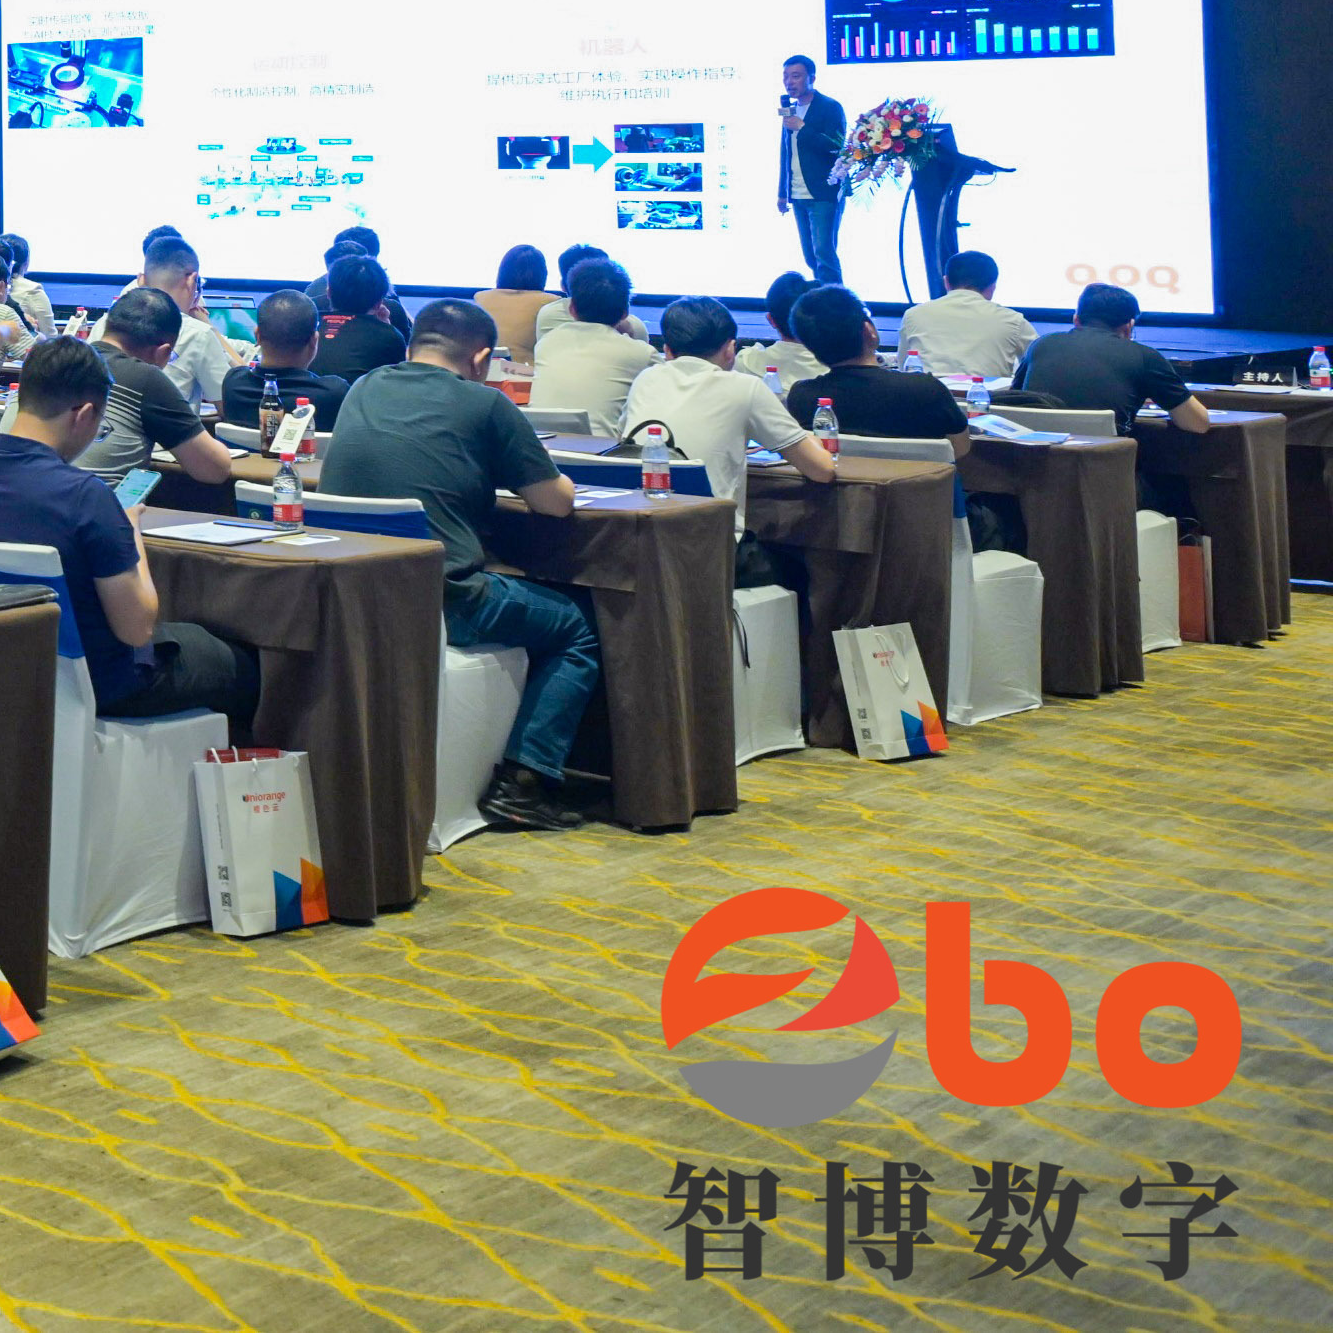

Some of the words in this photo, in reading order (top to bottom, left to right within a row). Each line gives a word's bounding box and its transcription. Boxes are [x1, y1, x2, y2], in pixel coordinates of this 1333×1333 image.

[579, 37, 648, 57] 机器人
[1242, 371, 1284, 383] 主持人
